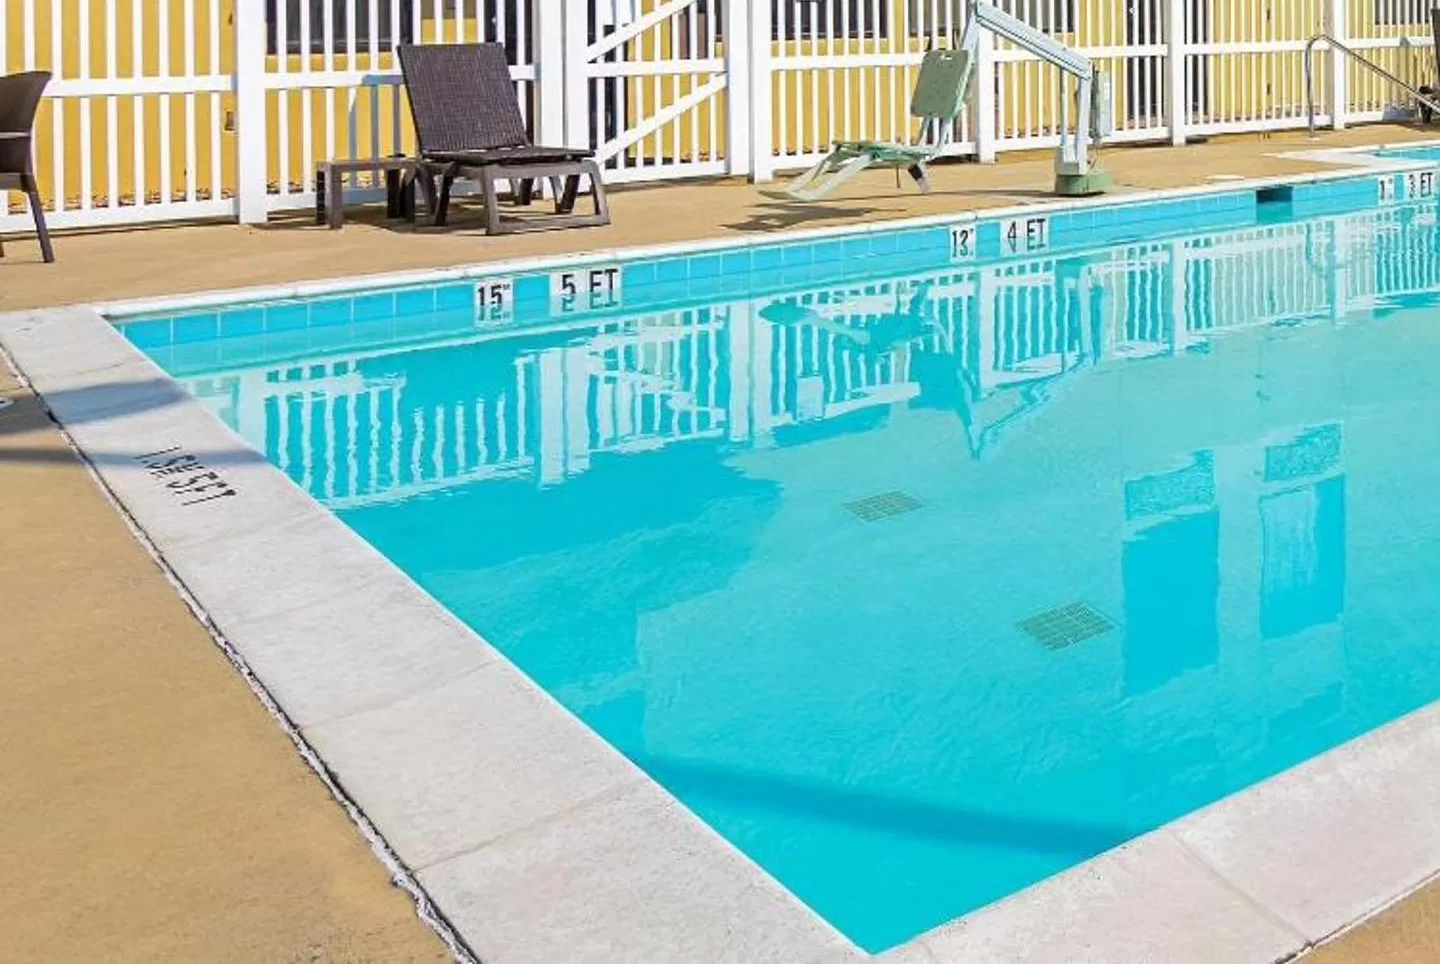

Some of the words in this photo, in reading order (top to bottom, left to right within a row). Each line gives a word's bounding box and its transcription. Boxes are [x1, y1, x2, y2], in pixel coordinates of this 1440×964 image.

[1026, 218, 1046, 240] FT
[561, 273, 576, 295] 5
[589, 268, 618, 294] FT
